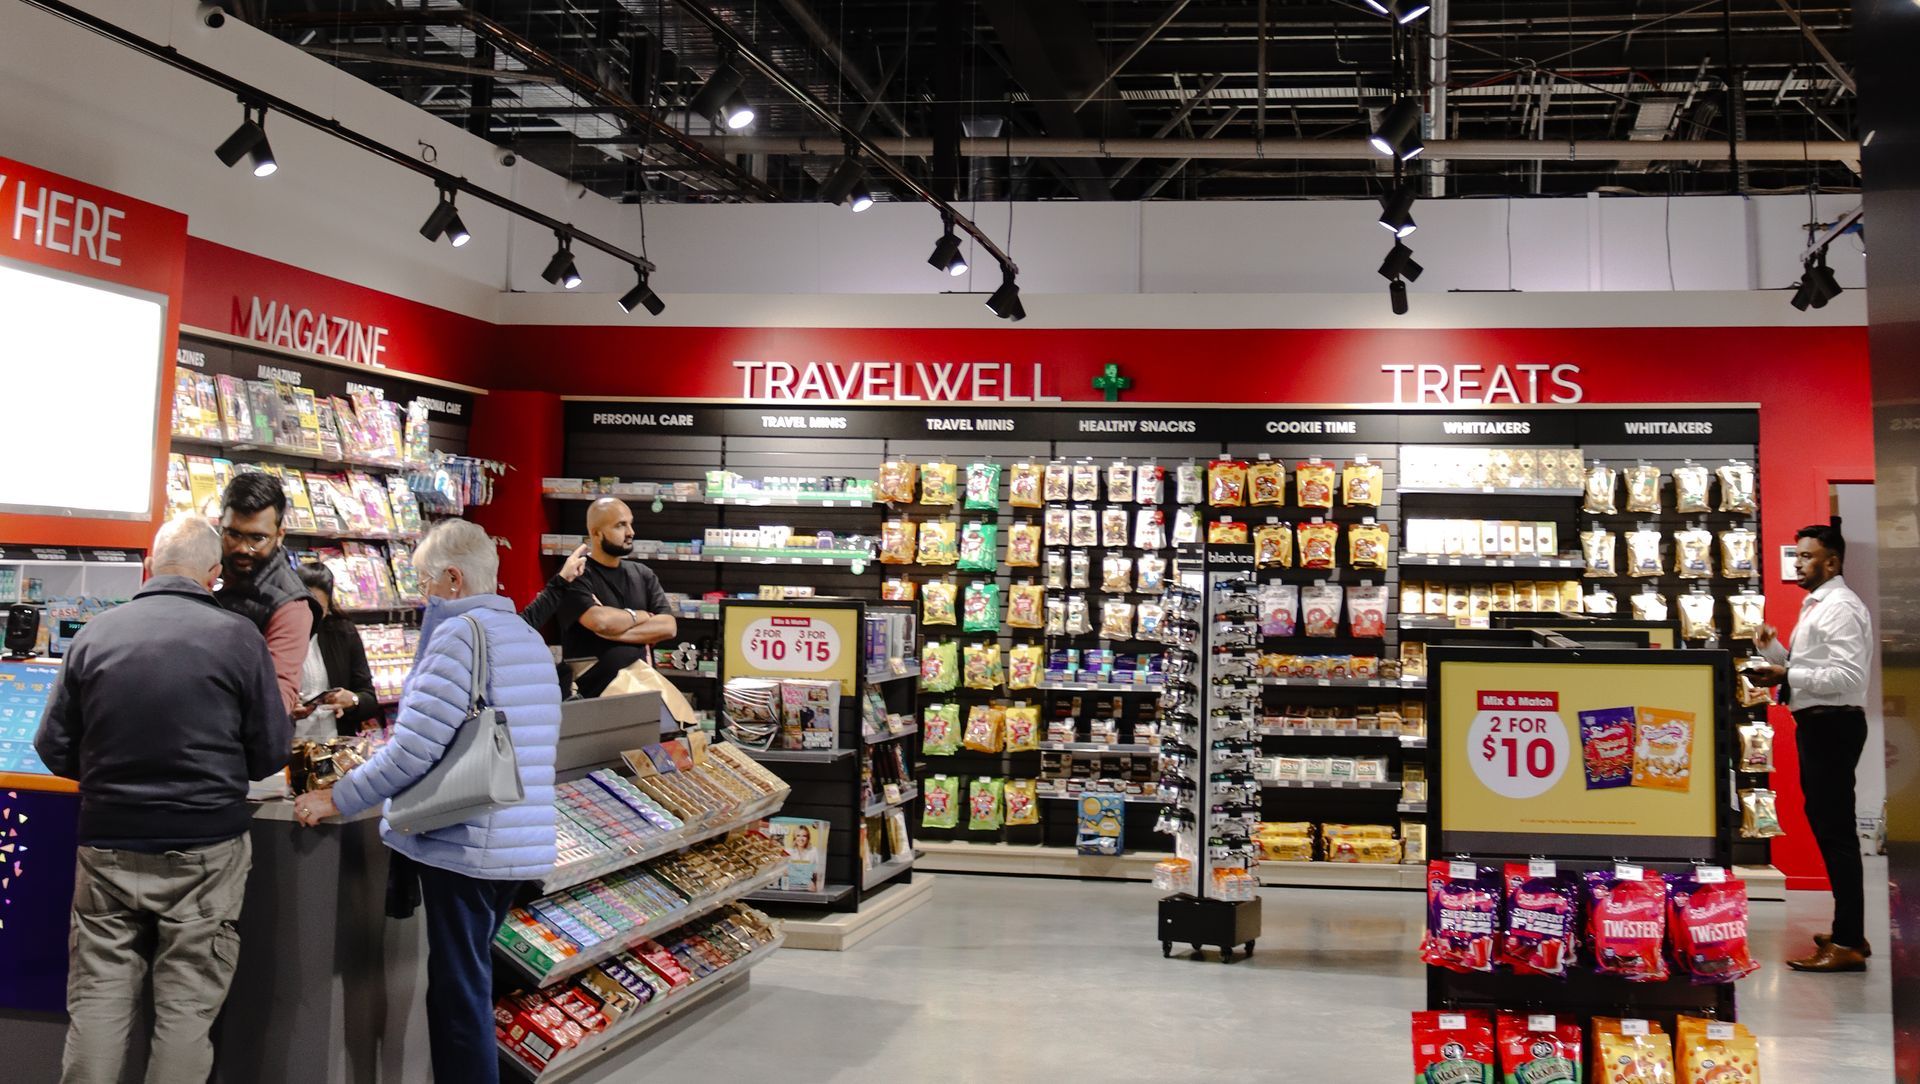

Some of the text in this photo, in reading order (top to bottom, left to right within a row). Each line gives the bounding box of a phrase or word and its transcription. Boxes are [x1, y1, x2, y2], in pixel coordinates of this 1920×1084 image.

[13, 180, 125, 267] HERE
[250, 296, 389, 369] MAGAZINE
[177, 349, 205, 368] AZINES
[257, 364, 301, 386] MAGAZINES
[732, 361, 1062, 402] TRAVELWELL
[1381, 363, 1584, 405] TREATS
[446, 401, 462, 415] CARE
[593, 413, 694, 427] PERSONAL CARE
[762, 416, 847, 429] TRAVEL MINIS
[926, 418, 1015, 432] TRAVEL MINIS
[1079, 420, 1196, 433] HEALTHY SNACKS
[1266, 421, 1356, 434] COOKIE TIME
[1443, 421, 1531, 434] WHITTAKERS
[1625, 421, 1713, 434] WHITTAKERS
[1208, 551, 1254, 563] black ice
[755, 629, 781, 638] 2 FOR
[799, 630, 826, 639] 3 FOR
[751, 638, 786, 661] $10
[795, 639, 830, 662] $15
[1483, 695, 1553, 707] Mix & Match
[1490, 716, 1547, 734] 2 FOR
[1483, 734, 1556, 779] $10
[1513, 907, 1564, 923] SHERBERT
